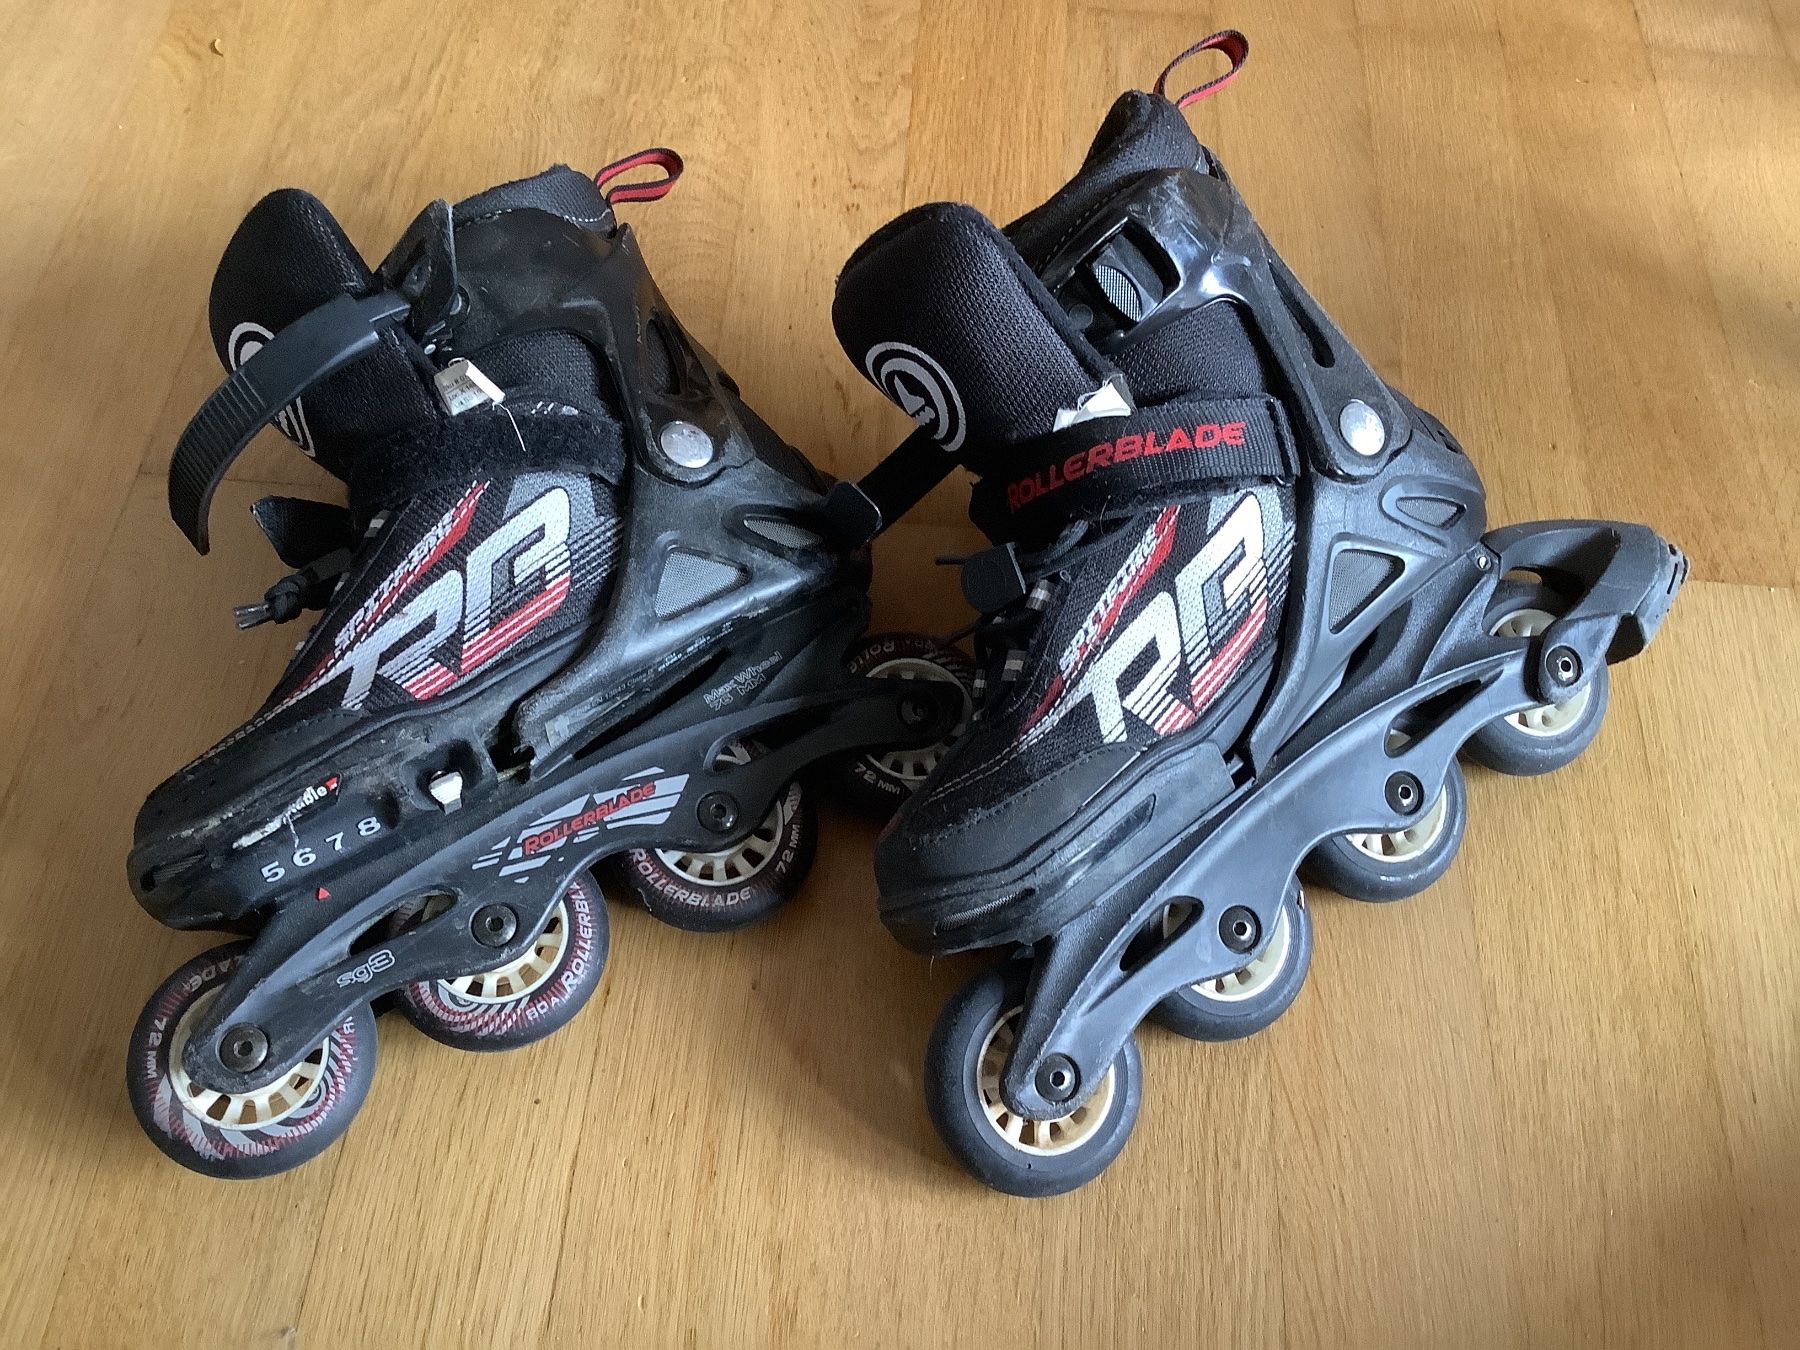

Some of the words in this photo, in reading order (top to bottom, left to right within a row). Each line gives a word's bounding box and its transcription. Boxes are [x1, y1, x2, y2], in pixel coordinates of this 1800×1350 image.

[1007, 421, 1246, 514] ROLLERBLADE
[854, 760, 876, 783] 72
[877, 779, 901, 796] MM
[523, 781, 656, 855] ROLLERBLADE
[261, 861, 286, 883] 5
[293, 847, 317, 867] 6
[325, 832, 344, 852] 7
[357, 816, 382, 837] 8
[775, 849, 794, 874] 72
[789, 824, 801, 848] MM
[630, 848, 752, 907] ROLLERBLADE
[147, 1016, 167, 1047] 72
[142, 1050, 159, 1078] MM
